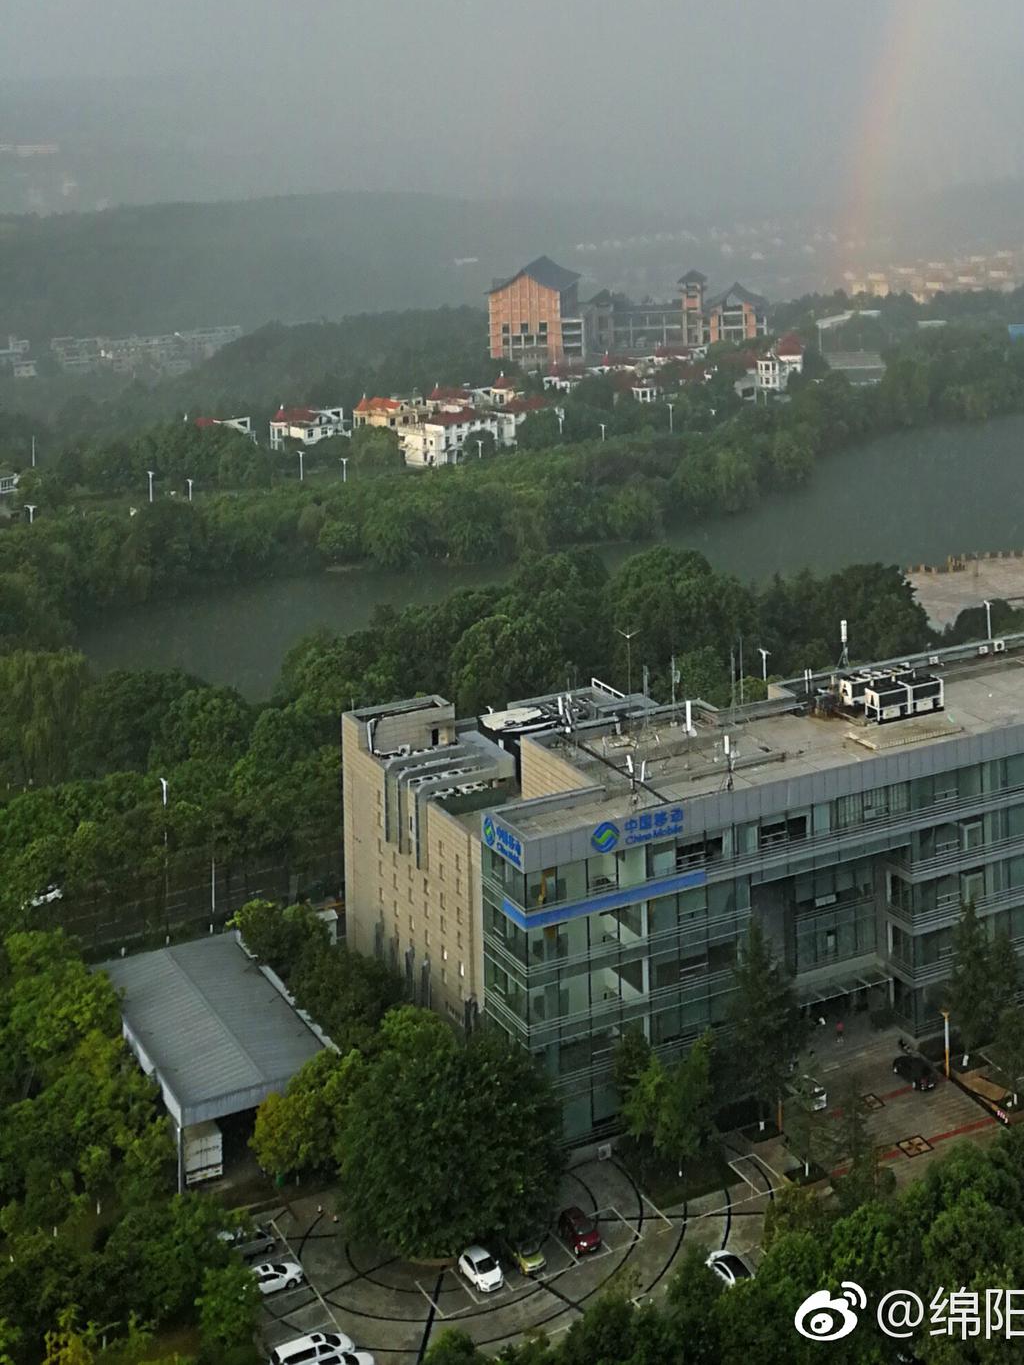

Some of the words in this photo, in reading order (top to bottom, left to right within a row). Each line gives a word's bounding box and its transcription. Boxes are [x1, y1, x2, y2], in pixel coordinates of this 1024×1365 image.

[624, 808, 684, 833] 中国移动
[625, 832, 652, 845] China
[653, 825, 683, 839] Mobile
